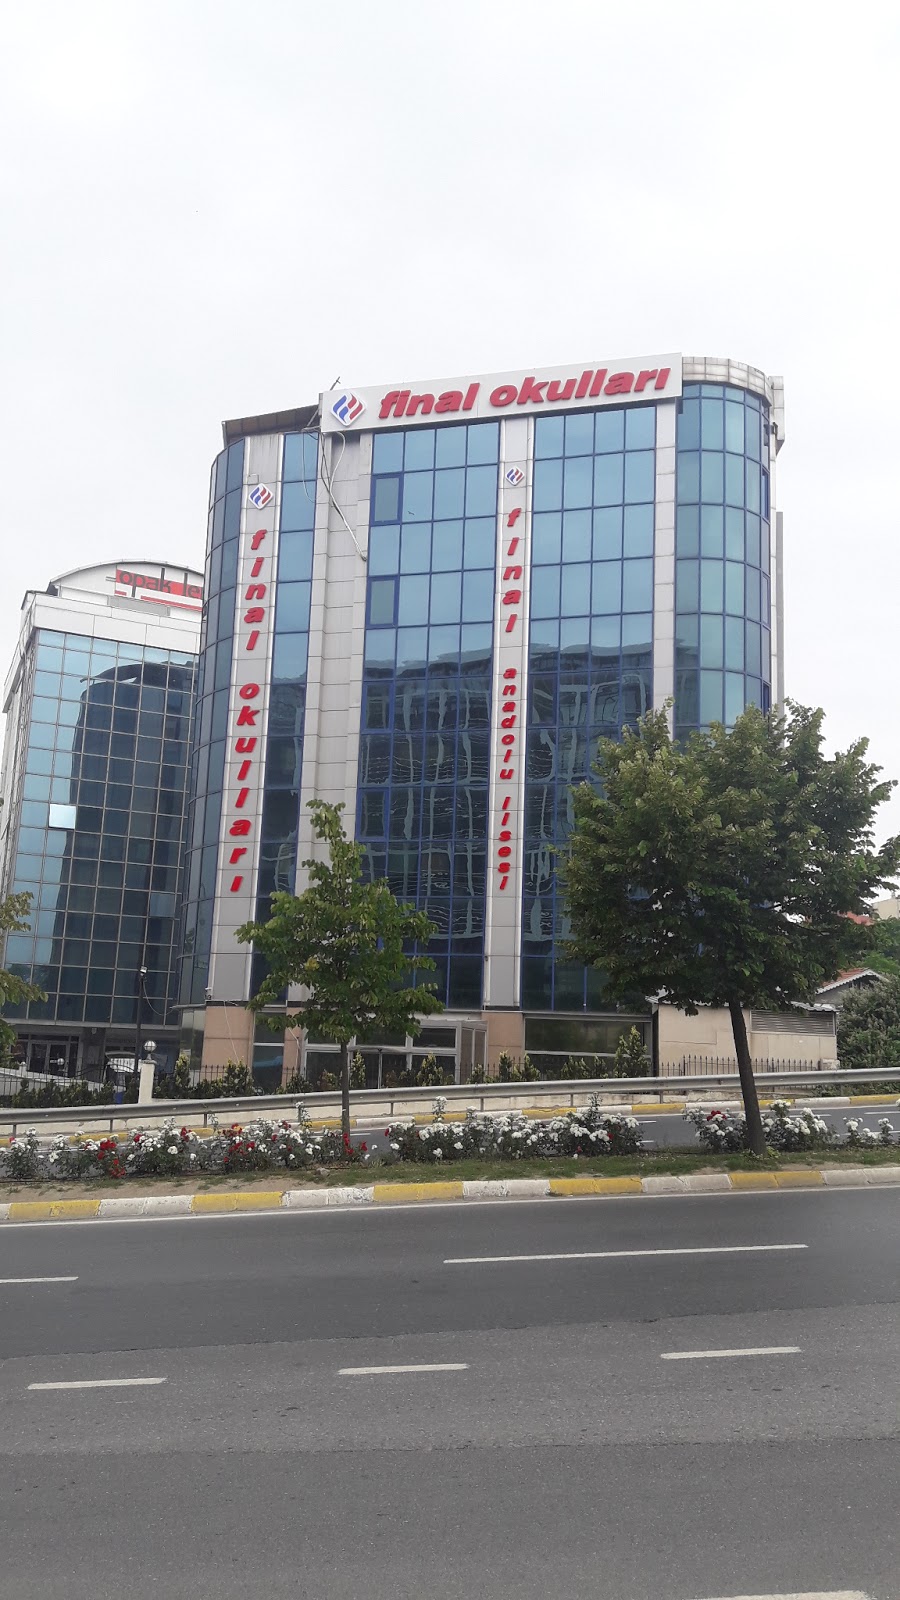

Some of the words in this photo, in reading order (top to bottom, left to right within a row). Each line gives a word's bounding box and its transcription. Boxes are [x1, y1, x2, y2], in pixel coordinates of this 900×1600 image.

[378, 383, 480, 418] final
[490, 368, 671, 407] okulları
[119, 567, 171, 598] opak
[243, 529, 267, 651] final
[502, 508, 522, 632] final
[499, 667, 517, 779] anadolu
